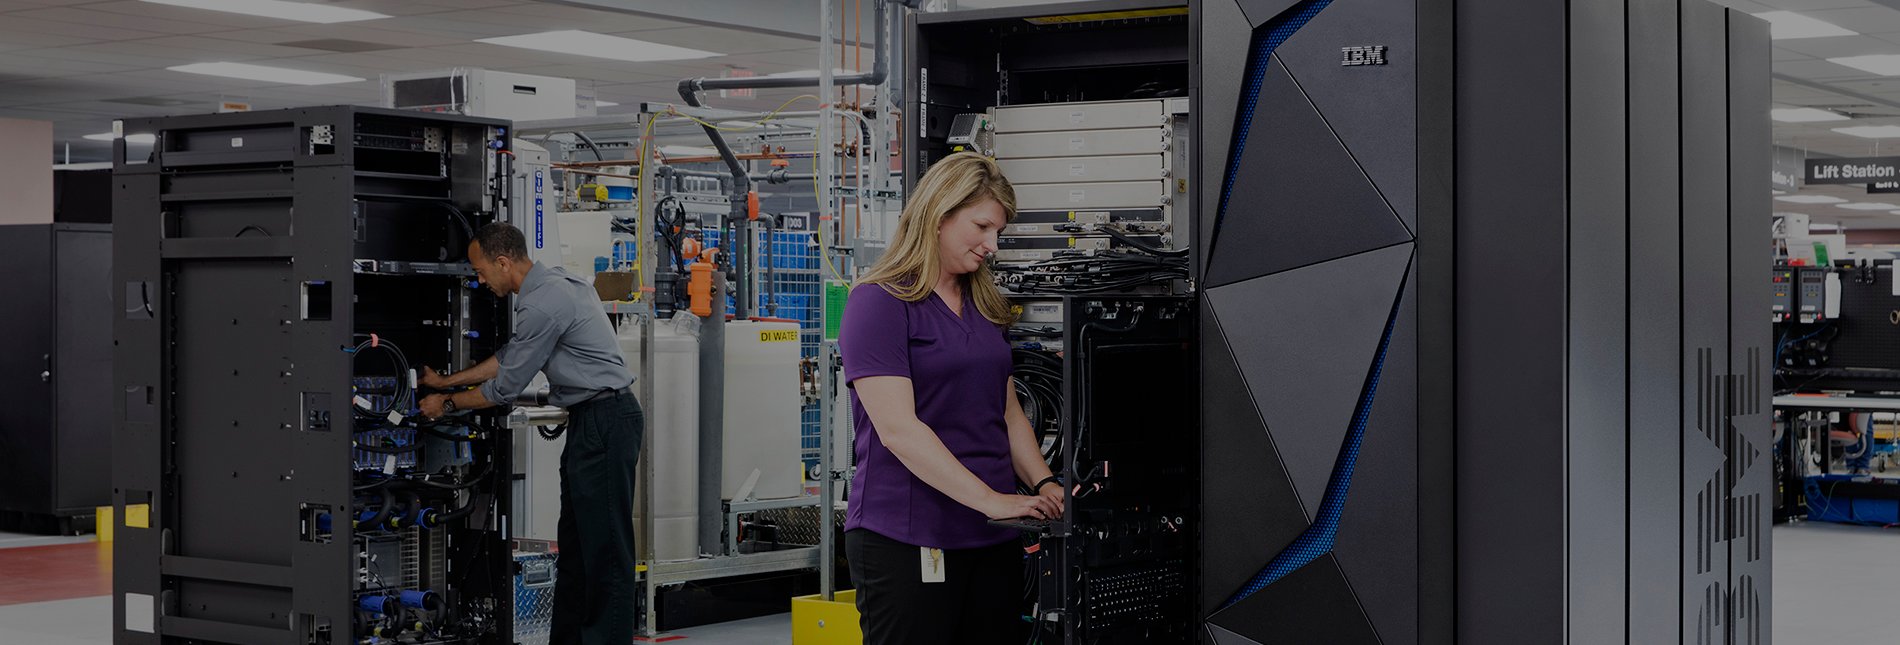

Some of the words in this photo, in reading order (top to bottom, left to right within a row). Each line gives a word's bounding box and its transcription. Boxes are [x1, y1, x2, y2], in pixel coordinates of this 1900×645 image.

[1342, 45, 1384, 66] IBM
[1814, 165, 1839, 179] Lift
[1842, 164, 1895, 178] Station
[761, 332, 771, 342] DI
[773, 331, 798, 341] WATER
